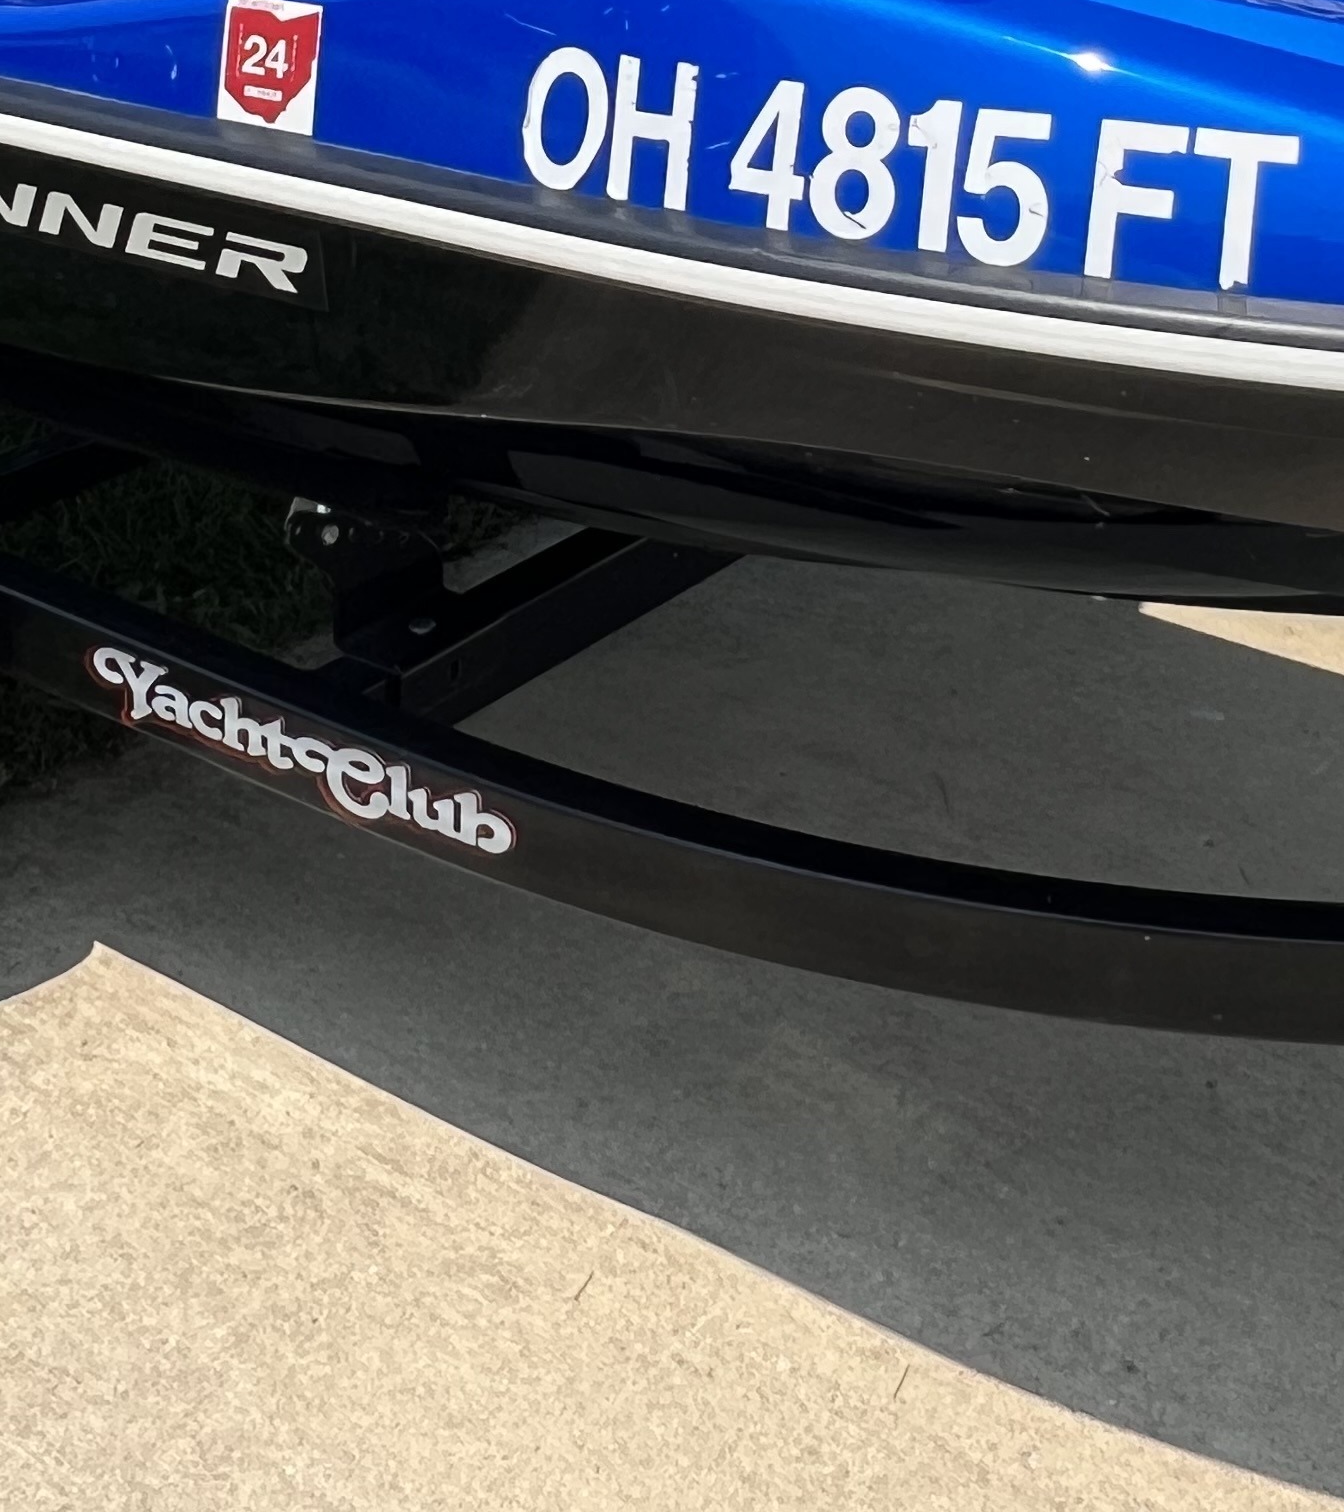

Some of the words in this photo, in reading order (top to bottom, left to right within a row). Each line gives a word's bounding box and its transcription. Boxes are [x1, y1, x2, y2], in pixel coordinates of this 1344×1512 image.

[242, 35, 288, 78] 24
[523, 47, 699, 212] OH
[729, 80, 1052, 266] 4815
[1084, 119, 1299, 290] FT
